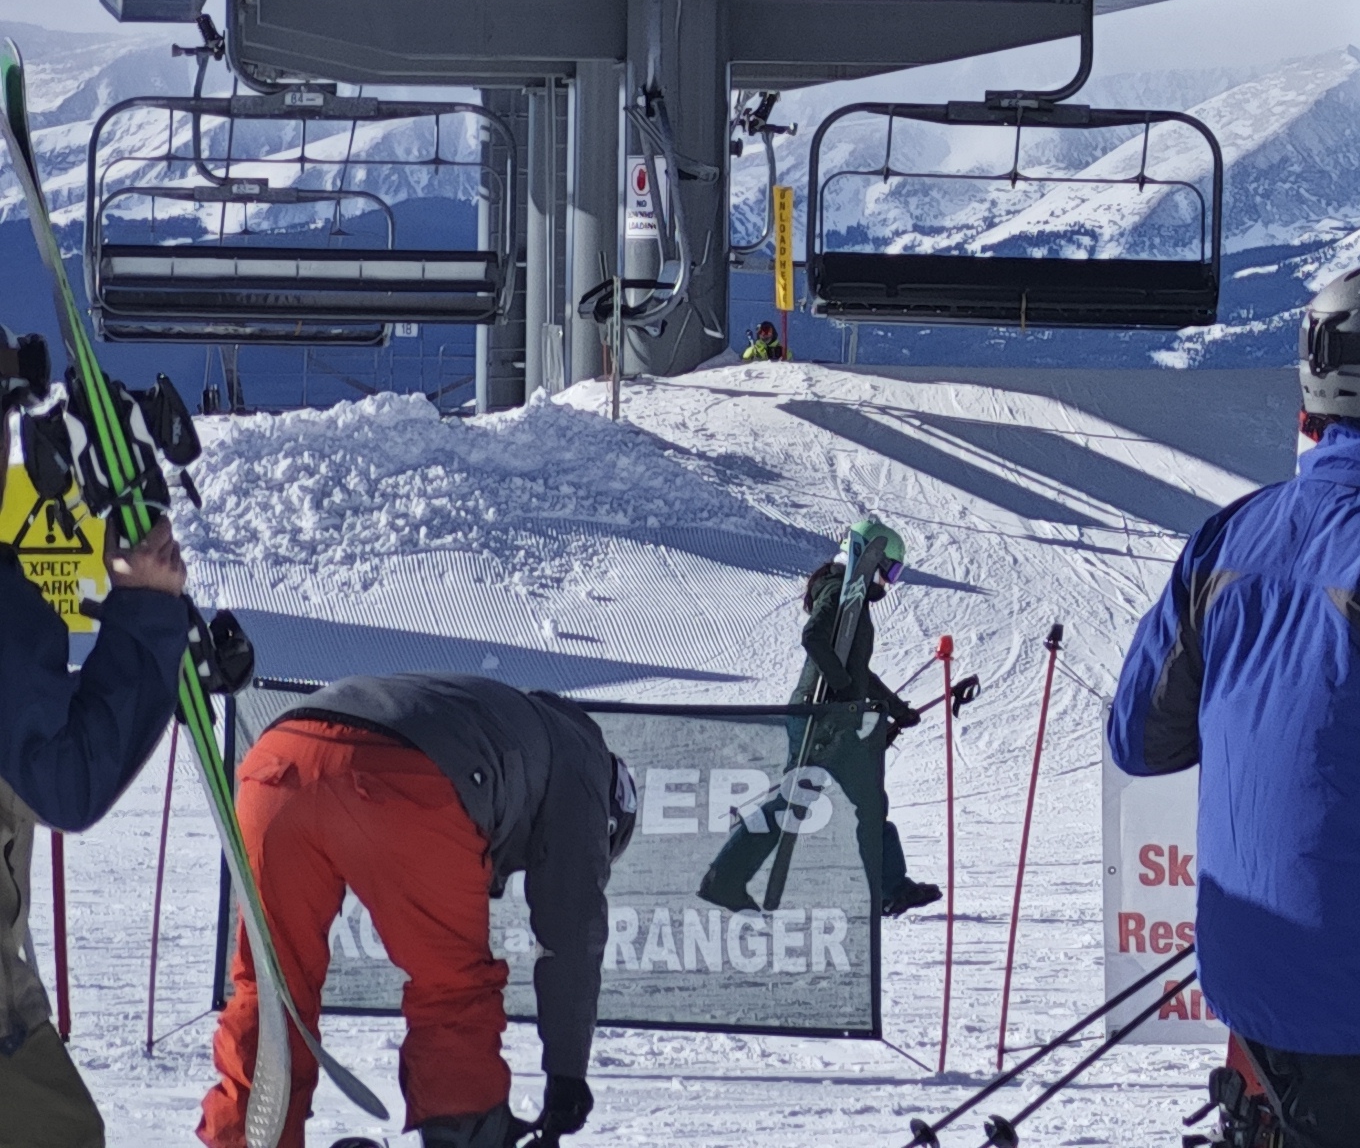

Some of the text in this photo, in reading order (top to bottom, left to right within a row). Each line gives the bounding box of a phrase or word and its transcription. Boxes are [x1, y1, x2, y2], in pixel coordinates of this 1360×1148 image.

[636, 199, 648, 208] NO
[23, 560, 81, 576] XPECT
[602, 907, 850, 972] RANGER
